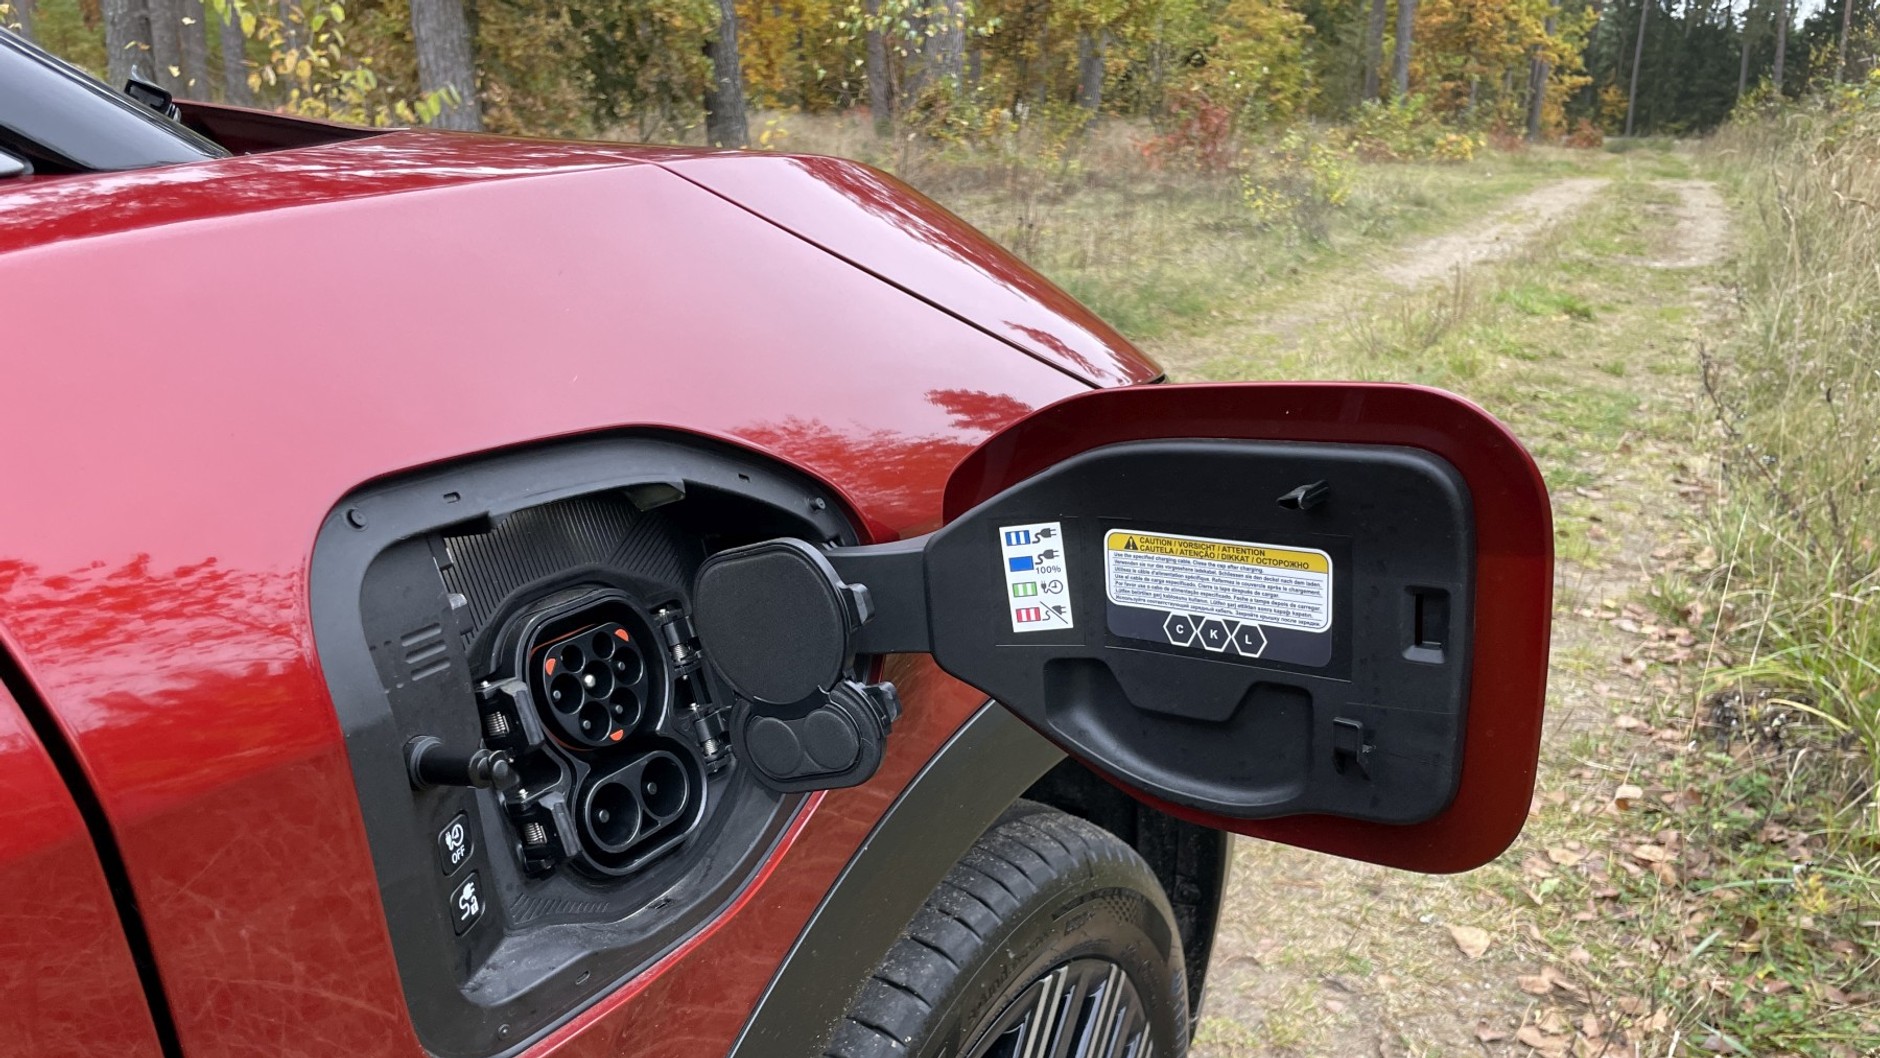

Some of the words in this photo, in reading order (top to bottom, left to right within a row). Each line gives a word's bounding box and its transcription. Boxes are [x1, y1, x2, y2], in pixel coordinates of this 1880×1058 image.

[1140, 537, 1173, 547] CAUTION
[1178, 541, 1215, 551] VORSICHT
[1222, 545, 1265, 556] ATTENTION
[1140, 545, 1174, 554] CAUTELA
[1180, 548, 1215, 560] ATENÇÃO
[1222, 553, 1249, 563] DIKKAT
[1036, 565, 1061, 574] 100%
[1176, 624, 1184, 634] C
[1210, 629, 1218, 640] K
[1245, 634, 1252, 644] L
[451, 844, 465, 864] OFF
